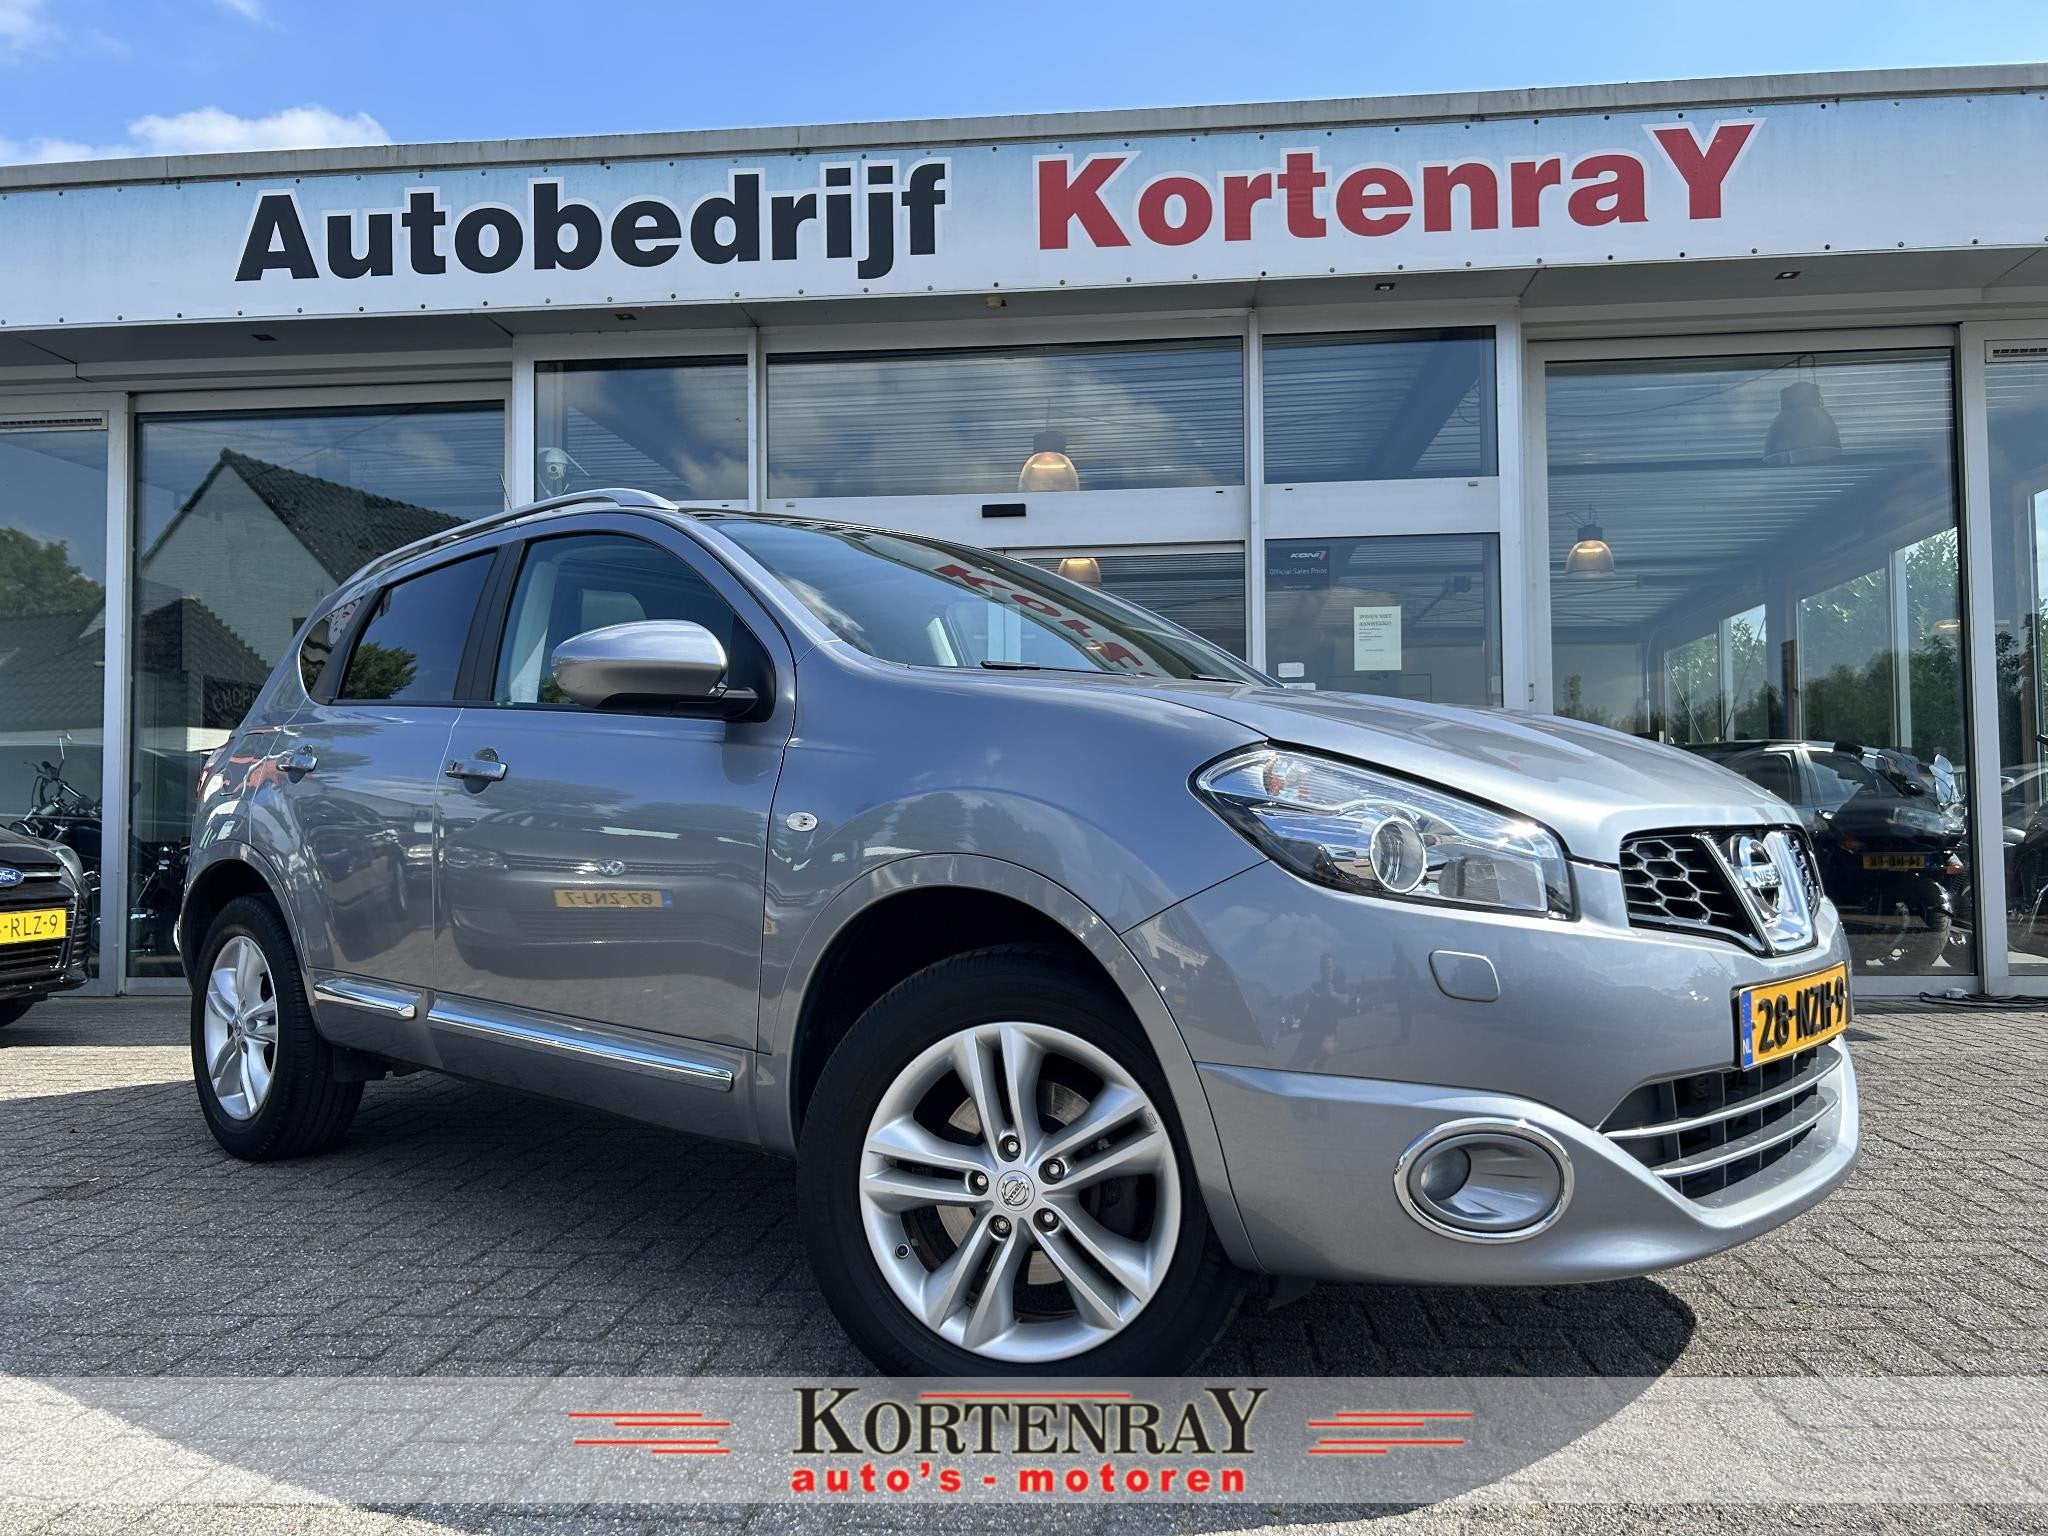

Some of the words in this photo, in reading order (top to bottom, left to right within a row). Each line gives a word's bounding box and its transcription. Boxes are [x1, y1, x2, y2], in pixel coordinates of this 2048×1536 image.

[235, 163, 946, 281] Autobedrijf
[1038, 122, 1757, 250] KortenraY
[1268, 566, 1291, 576] Official
[1292, 567, 1310, 576] Sales
[1310, 567, 1328, 576] Point
[0, 914, 58, 939] -RLZ-9
[1757, 975, 1845, 1055] 28-NZH-9
[1742, 1038, 1752, 1054] NL
